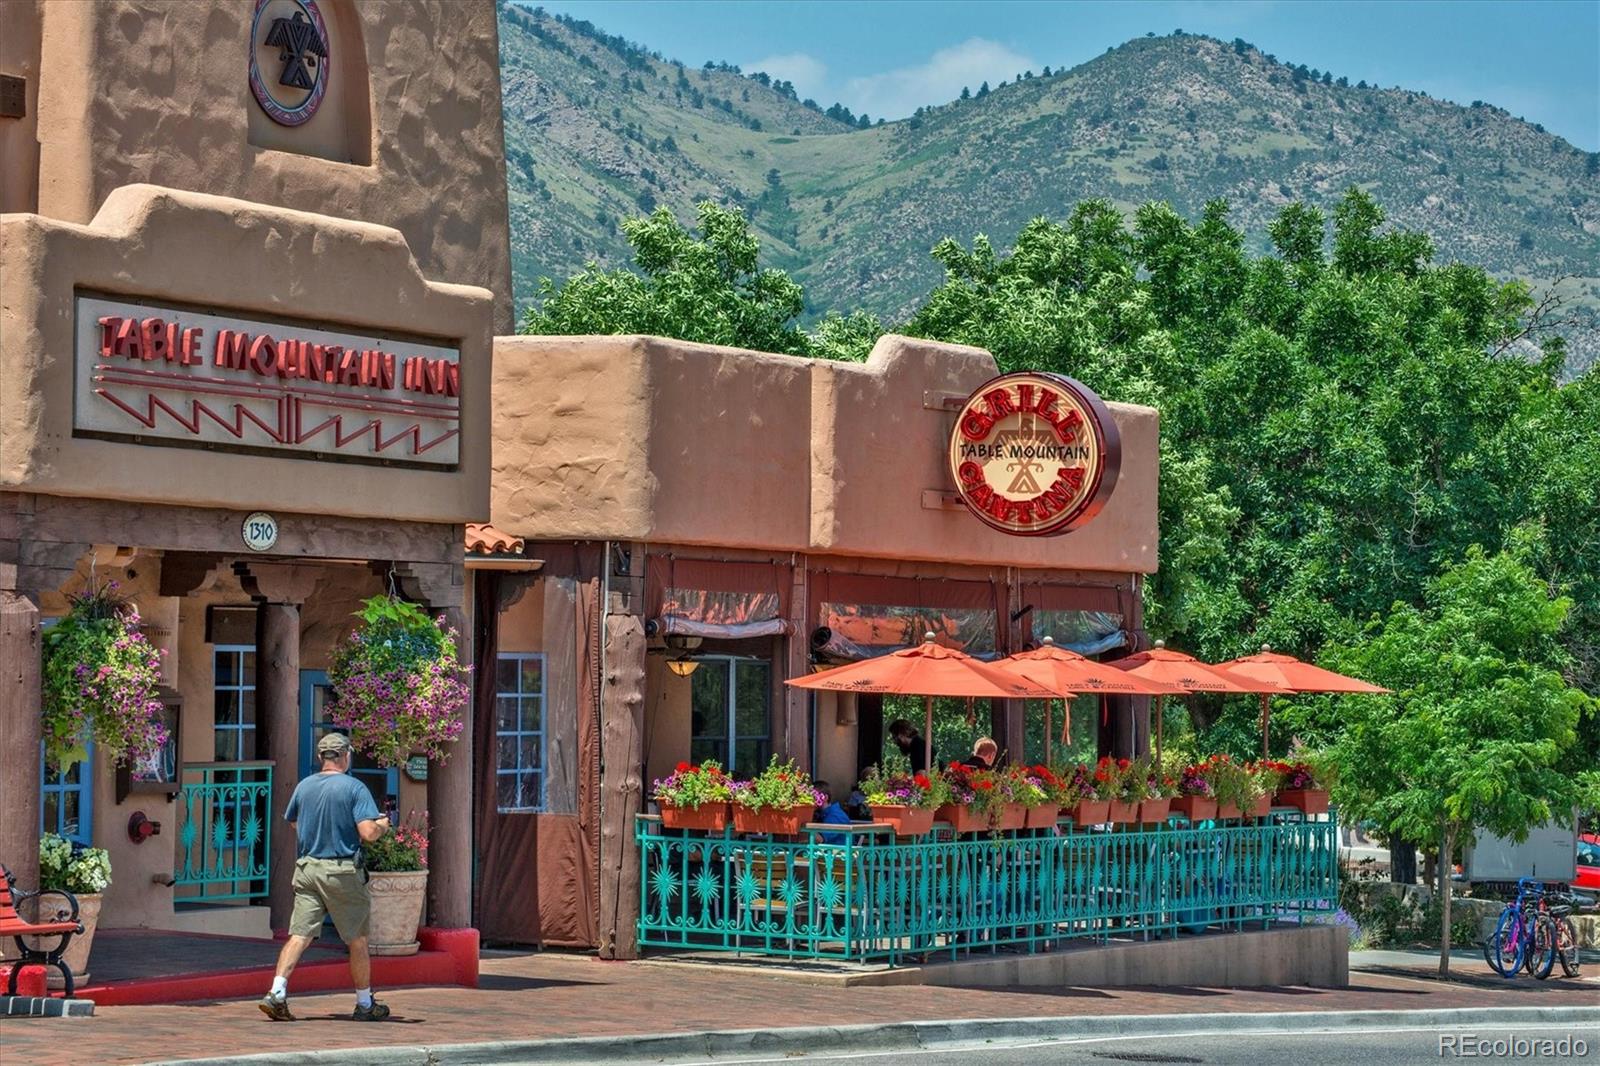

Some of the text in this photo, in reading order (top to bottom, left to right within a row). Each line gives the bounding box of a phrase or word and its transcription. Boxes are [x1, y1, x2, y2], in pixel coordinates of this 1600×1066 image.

[98, 316, 460, 397] TABLE MOUNTAIN INN
[960, 384, 1084, 444] GRILL
[960, 444, 1089, 460] TABLE MOUNTAIN
[958, 461, 1086, 524] CANTINA
[250, 522, 274, 540] 1310
